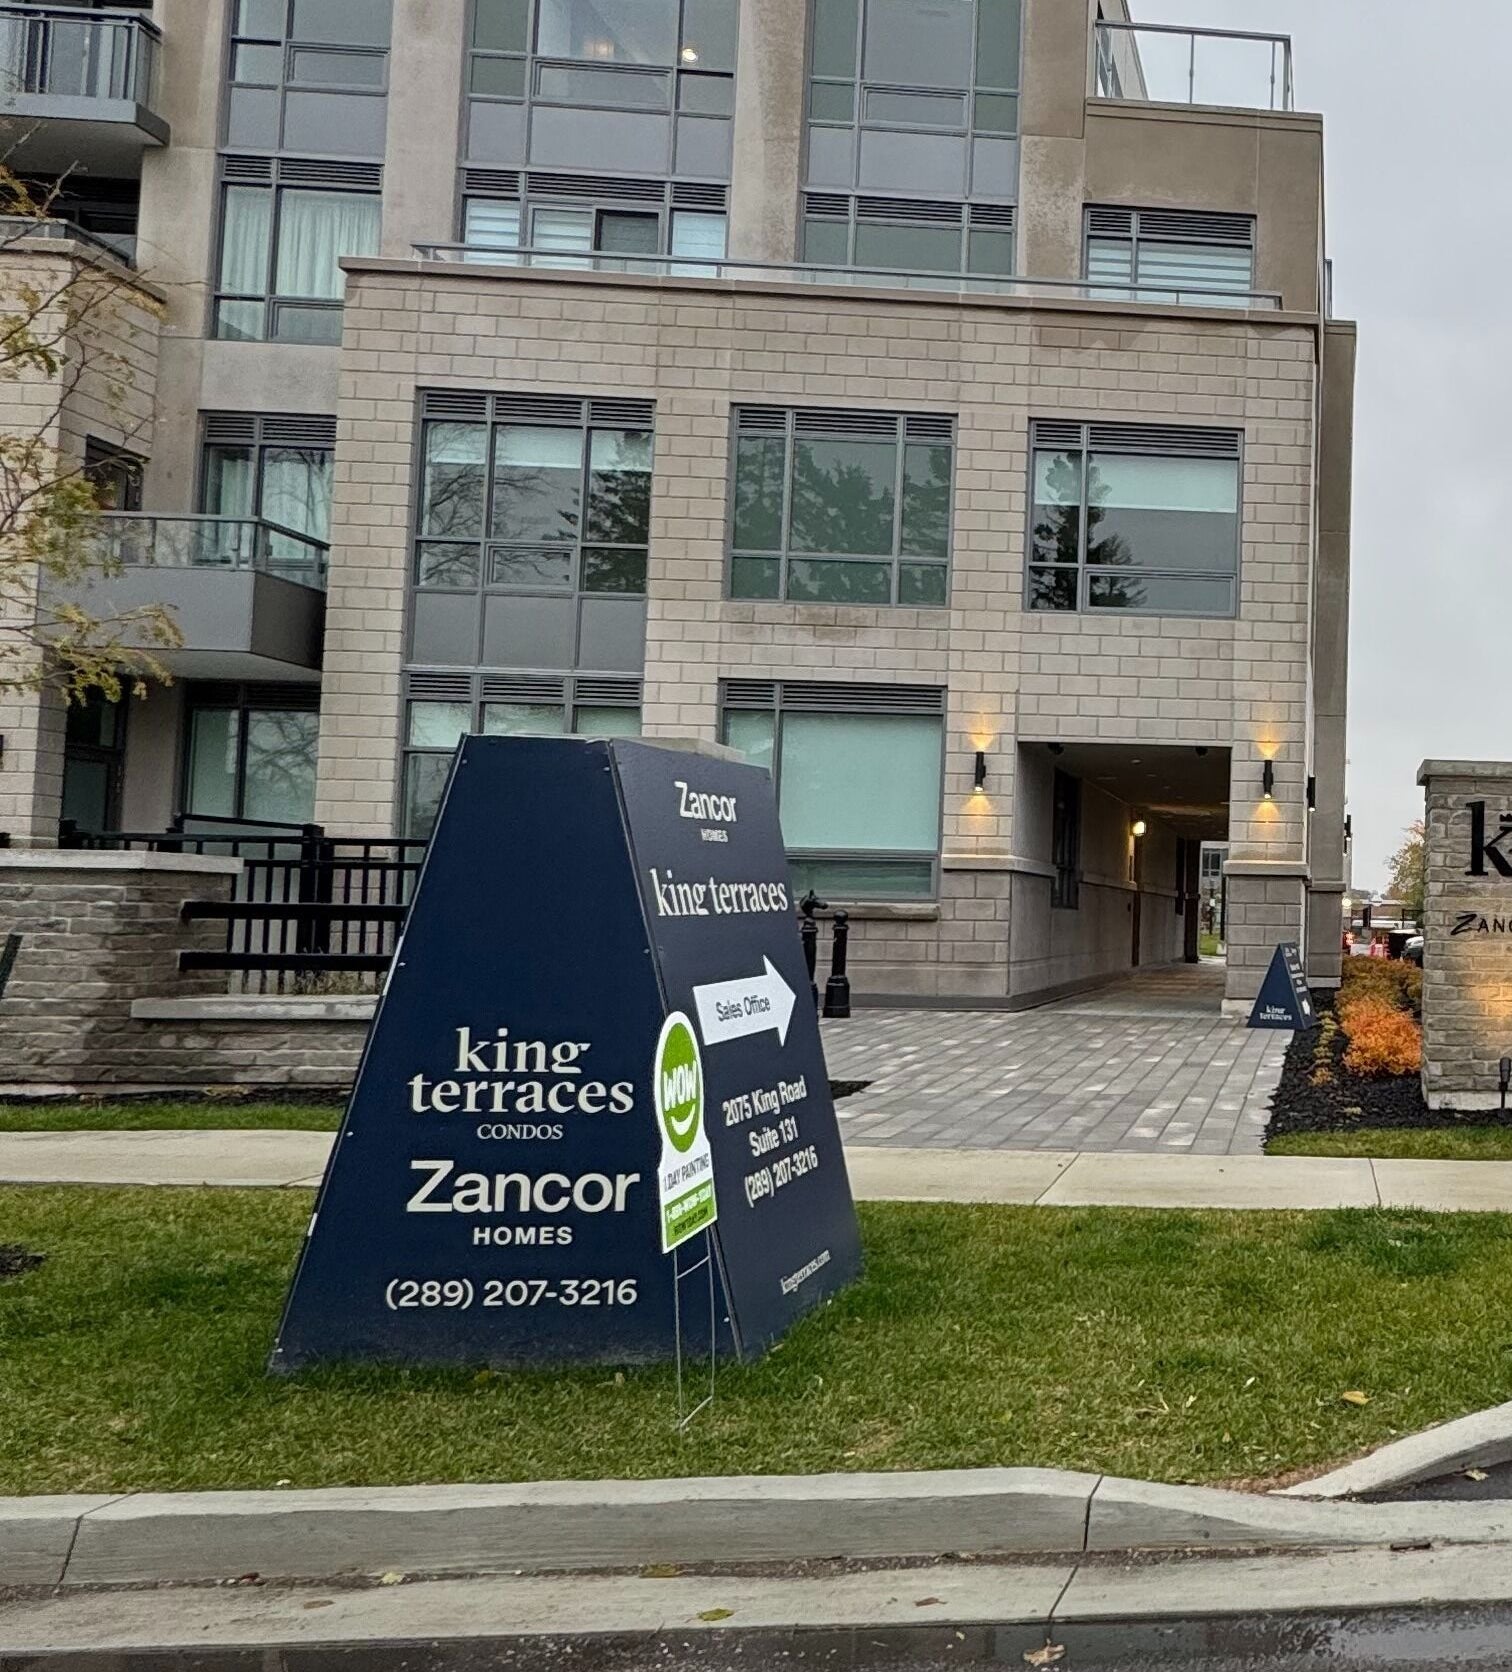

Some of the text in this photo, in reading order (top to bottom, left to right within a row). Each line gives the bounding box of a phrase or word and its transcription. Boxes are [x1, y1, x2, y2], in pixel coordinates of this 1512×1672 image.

[674, 781, 737, 822] Zancor
[701, 828, 728, 842] HOMES
[650, 868, 789, 916] king terraces
[716, 995, 770, 1021] Sales Office
[454, 1026, 592, 1074] king
[406, 1073, 635, 1114] terraces
[663, 1060, 697, 1112] WOW
[722, 1074, 807, 1127] 2075 King Road
[476, 1123, 564, 1140] CONDOS
[749, 1116, 798, 1157] Suite 131
[406, 1160, 641, 1213] Zancor
[668, 1168, 680, 1191] DAY
[744, 1166, 775, 1209] (289)
[772, 1144, 819, 1188] 207-3216
[473, 1226, 573, 1246] HOMES
[386, 1278, 638, 1311] (289) 207-3216
